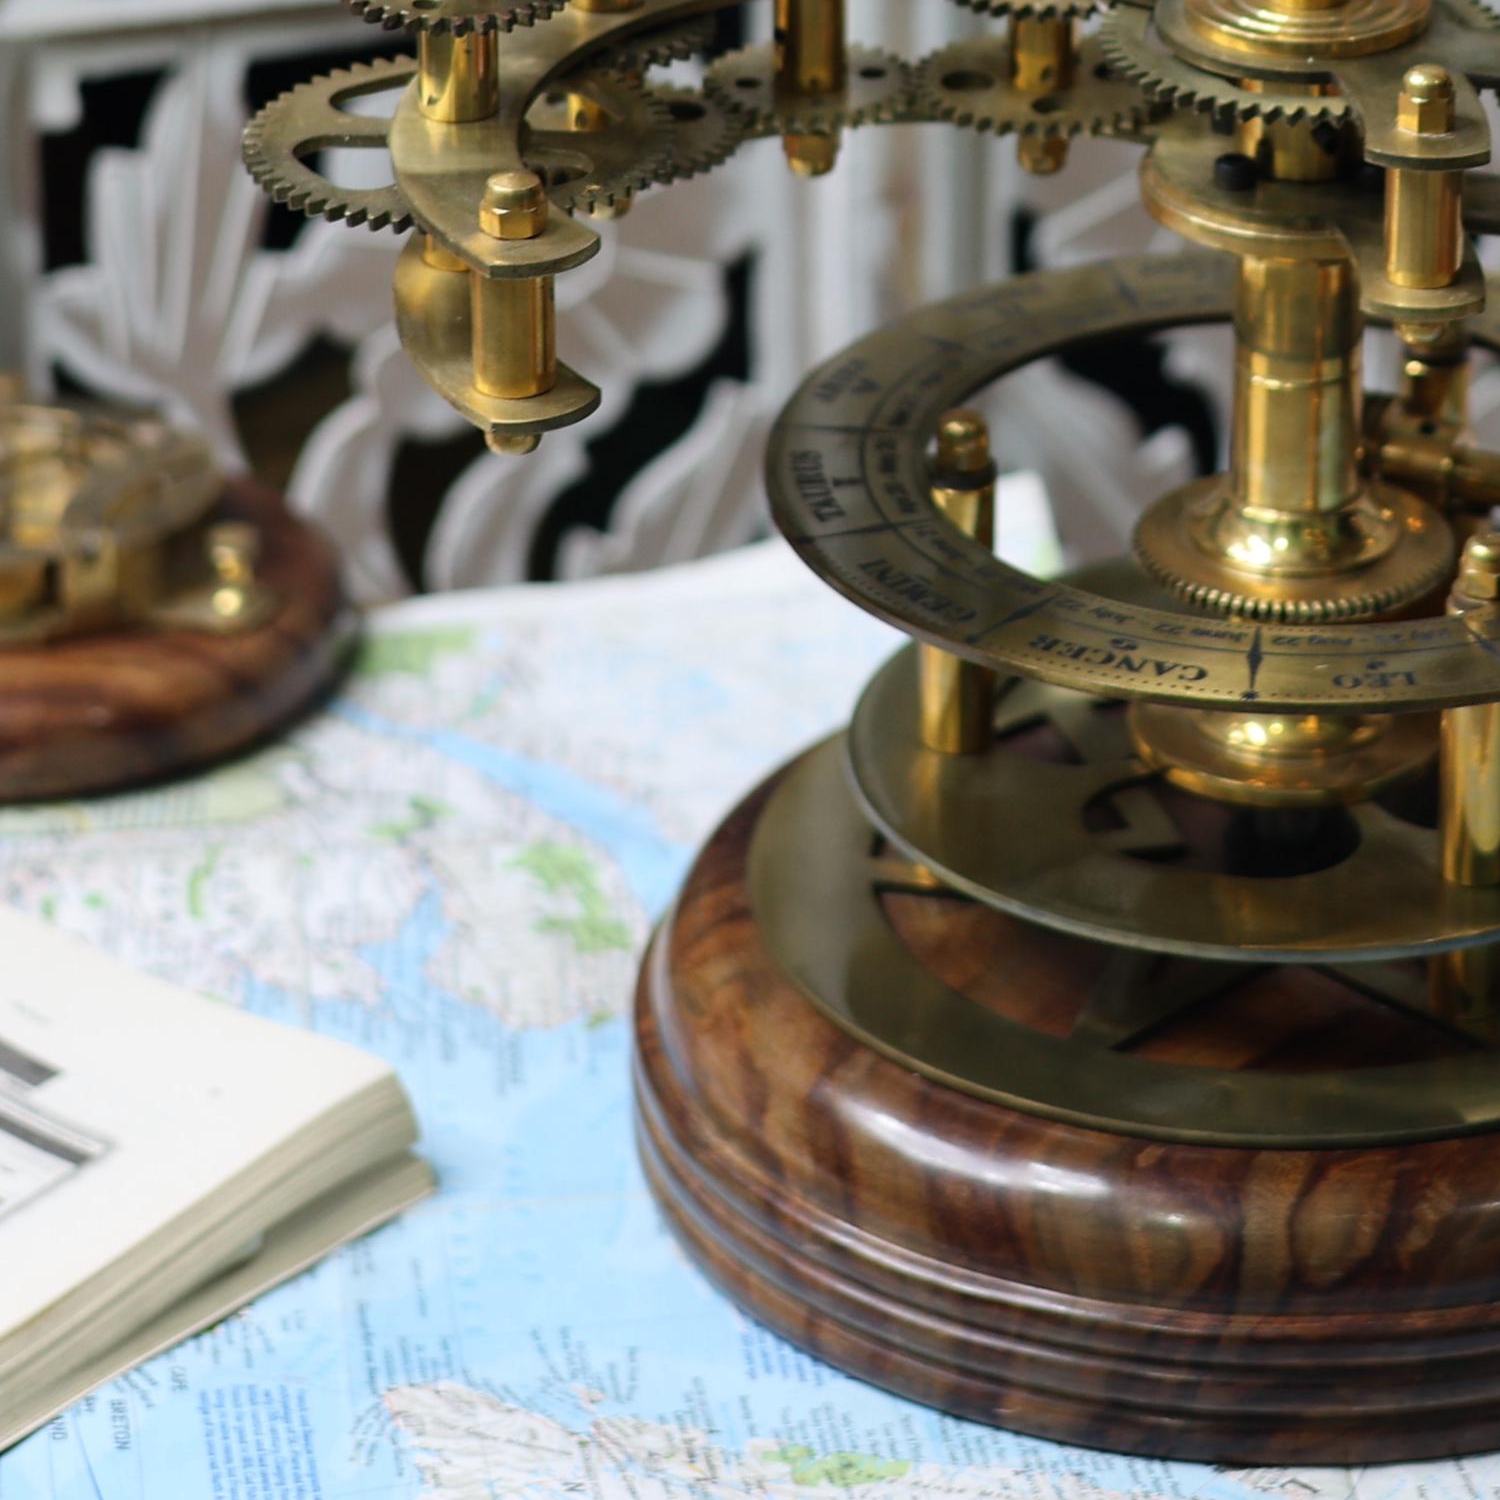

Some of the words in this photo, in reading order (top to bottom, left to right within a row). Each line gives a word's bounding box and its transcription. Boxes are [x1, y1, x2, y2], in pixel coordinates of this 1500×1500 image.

[1028, 632, 1210, 683] CANCER
[1332, 669, 1420, 690] LEO
[109, 1398, 132, 1451] BRETON
